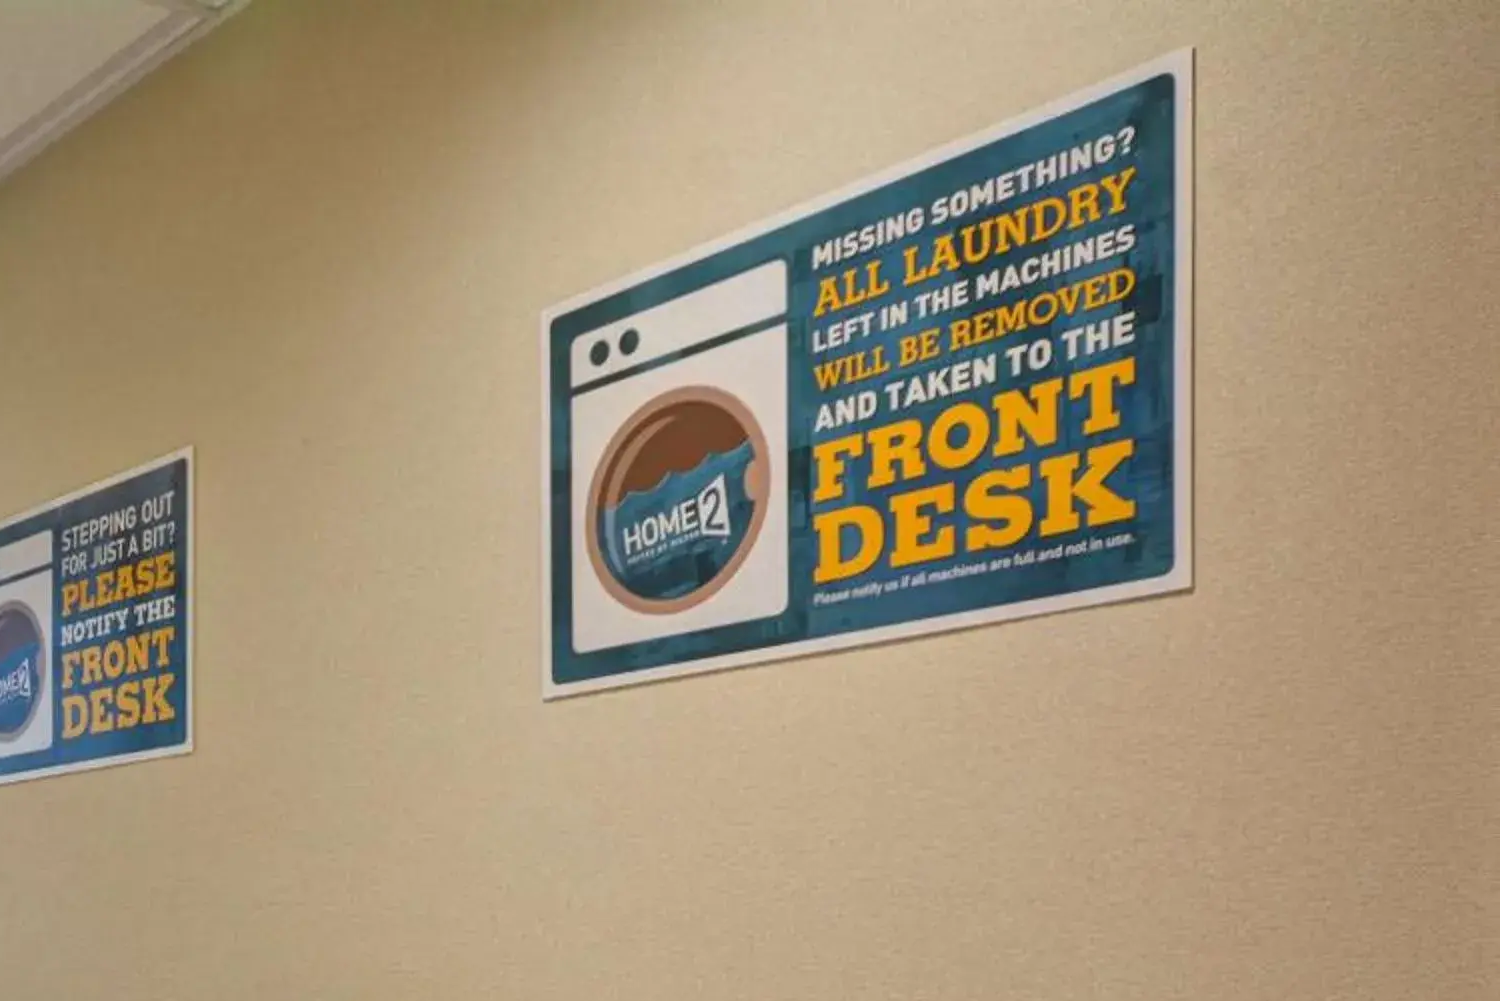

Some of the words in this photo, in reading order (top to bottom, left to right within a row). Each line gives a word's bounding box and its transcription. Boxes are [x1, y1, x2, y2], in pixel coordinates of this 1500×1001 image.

[812, 207, 925, 270] MISSING
[931, 126, 1137, 226] SOMETHING?
[813, 260, 891, 316] ALL
[903, 167, 1137, 287] LAUNDRY
[812, 310, 875, 353] LEFT
[880, 303, 908, 329] IN
[914, 280, 969, 319] THE
[975, 224, 1137, 299] MACHINES
[813, 345, 891, 391] WILL
[899, 328, 940, 367] BE
[949, 267, 1137, 346] REMOVED
[814, 391, 877, 432] AND
[884, 354, 996, 411] TAKEN
[1005, 338, 1053, 376] TO
[1061, 311, 1137, 357] THE
[812, 357, 1137, 503] FRONT
[61, 505, 137, 552] STEPPING
[141, 489, 175, 523] OUT
[61, 551, 87, 577] FOR
[90, 538, 126, 568] JUST
[127, 534, 139, 557] A
[143, 520, 175, 552] BIT?
[812, 439, 1137, 584] DESK
[61, 550, 175, 617] PLEASE
[813, 588, 850, 606] Please
[852, 582, 883, 598] notify
[884, 580, 899, 592] us
[900, 575, 911, 590] if
[911, 571, 927, 587] all
[928, 562, 987, 583] machines
[989, 557, 1012, 572] are
[1013, 550, 1036, 567] full
[1037, 544, 1063, 562] and
[1065, 540, 1088, 557] not
[1089, 536, 1104, 550] in
[61, 607, 128, 646] NOTIFY
[134, 594, 175, 626] THE
[62, 625, 175, 689] FRONT
[62, 673, 175, 739] DESK
